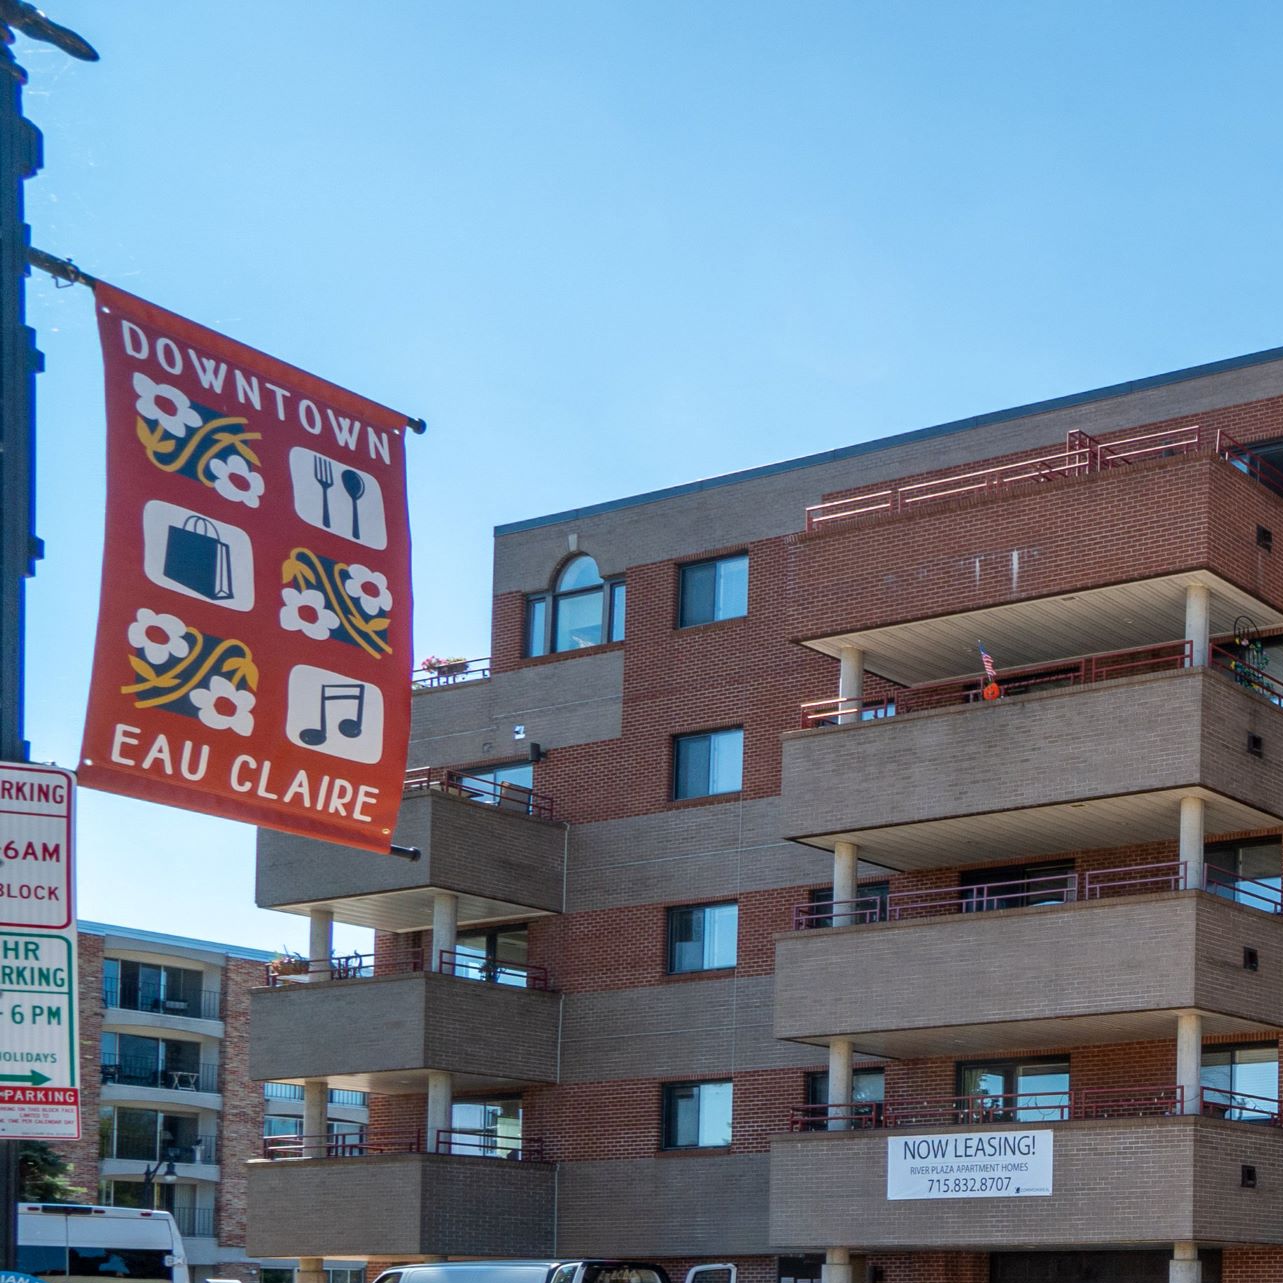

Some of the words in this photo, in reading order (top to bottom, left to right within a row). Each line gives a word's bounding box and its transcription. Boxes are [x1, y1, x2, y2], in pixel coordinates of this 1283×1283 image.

[121, 319, 391, 466] DOWNTOWN
[110, 723, 210, 781] EAU
[230, 754, 380, 823] CLAIRE
[3, 940, 40, 961] HR
[0, 1051, 58, 1063] OLIDAYS
[903, 1139, 949, 1160] NOW
[954, 1135, 1036, 1158] LEASING!
[910, 1166, 930, 1175] RIVER
[931, 1165, 954, 1175] PLAZA
[956, 1163, 1000, 1174] APARTMENT
[1001, 1162, 1029, 1172] HOMES
[927, 1177, 1012, 1193] 715.832.8707
